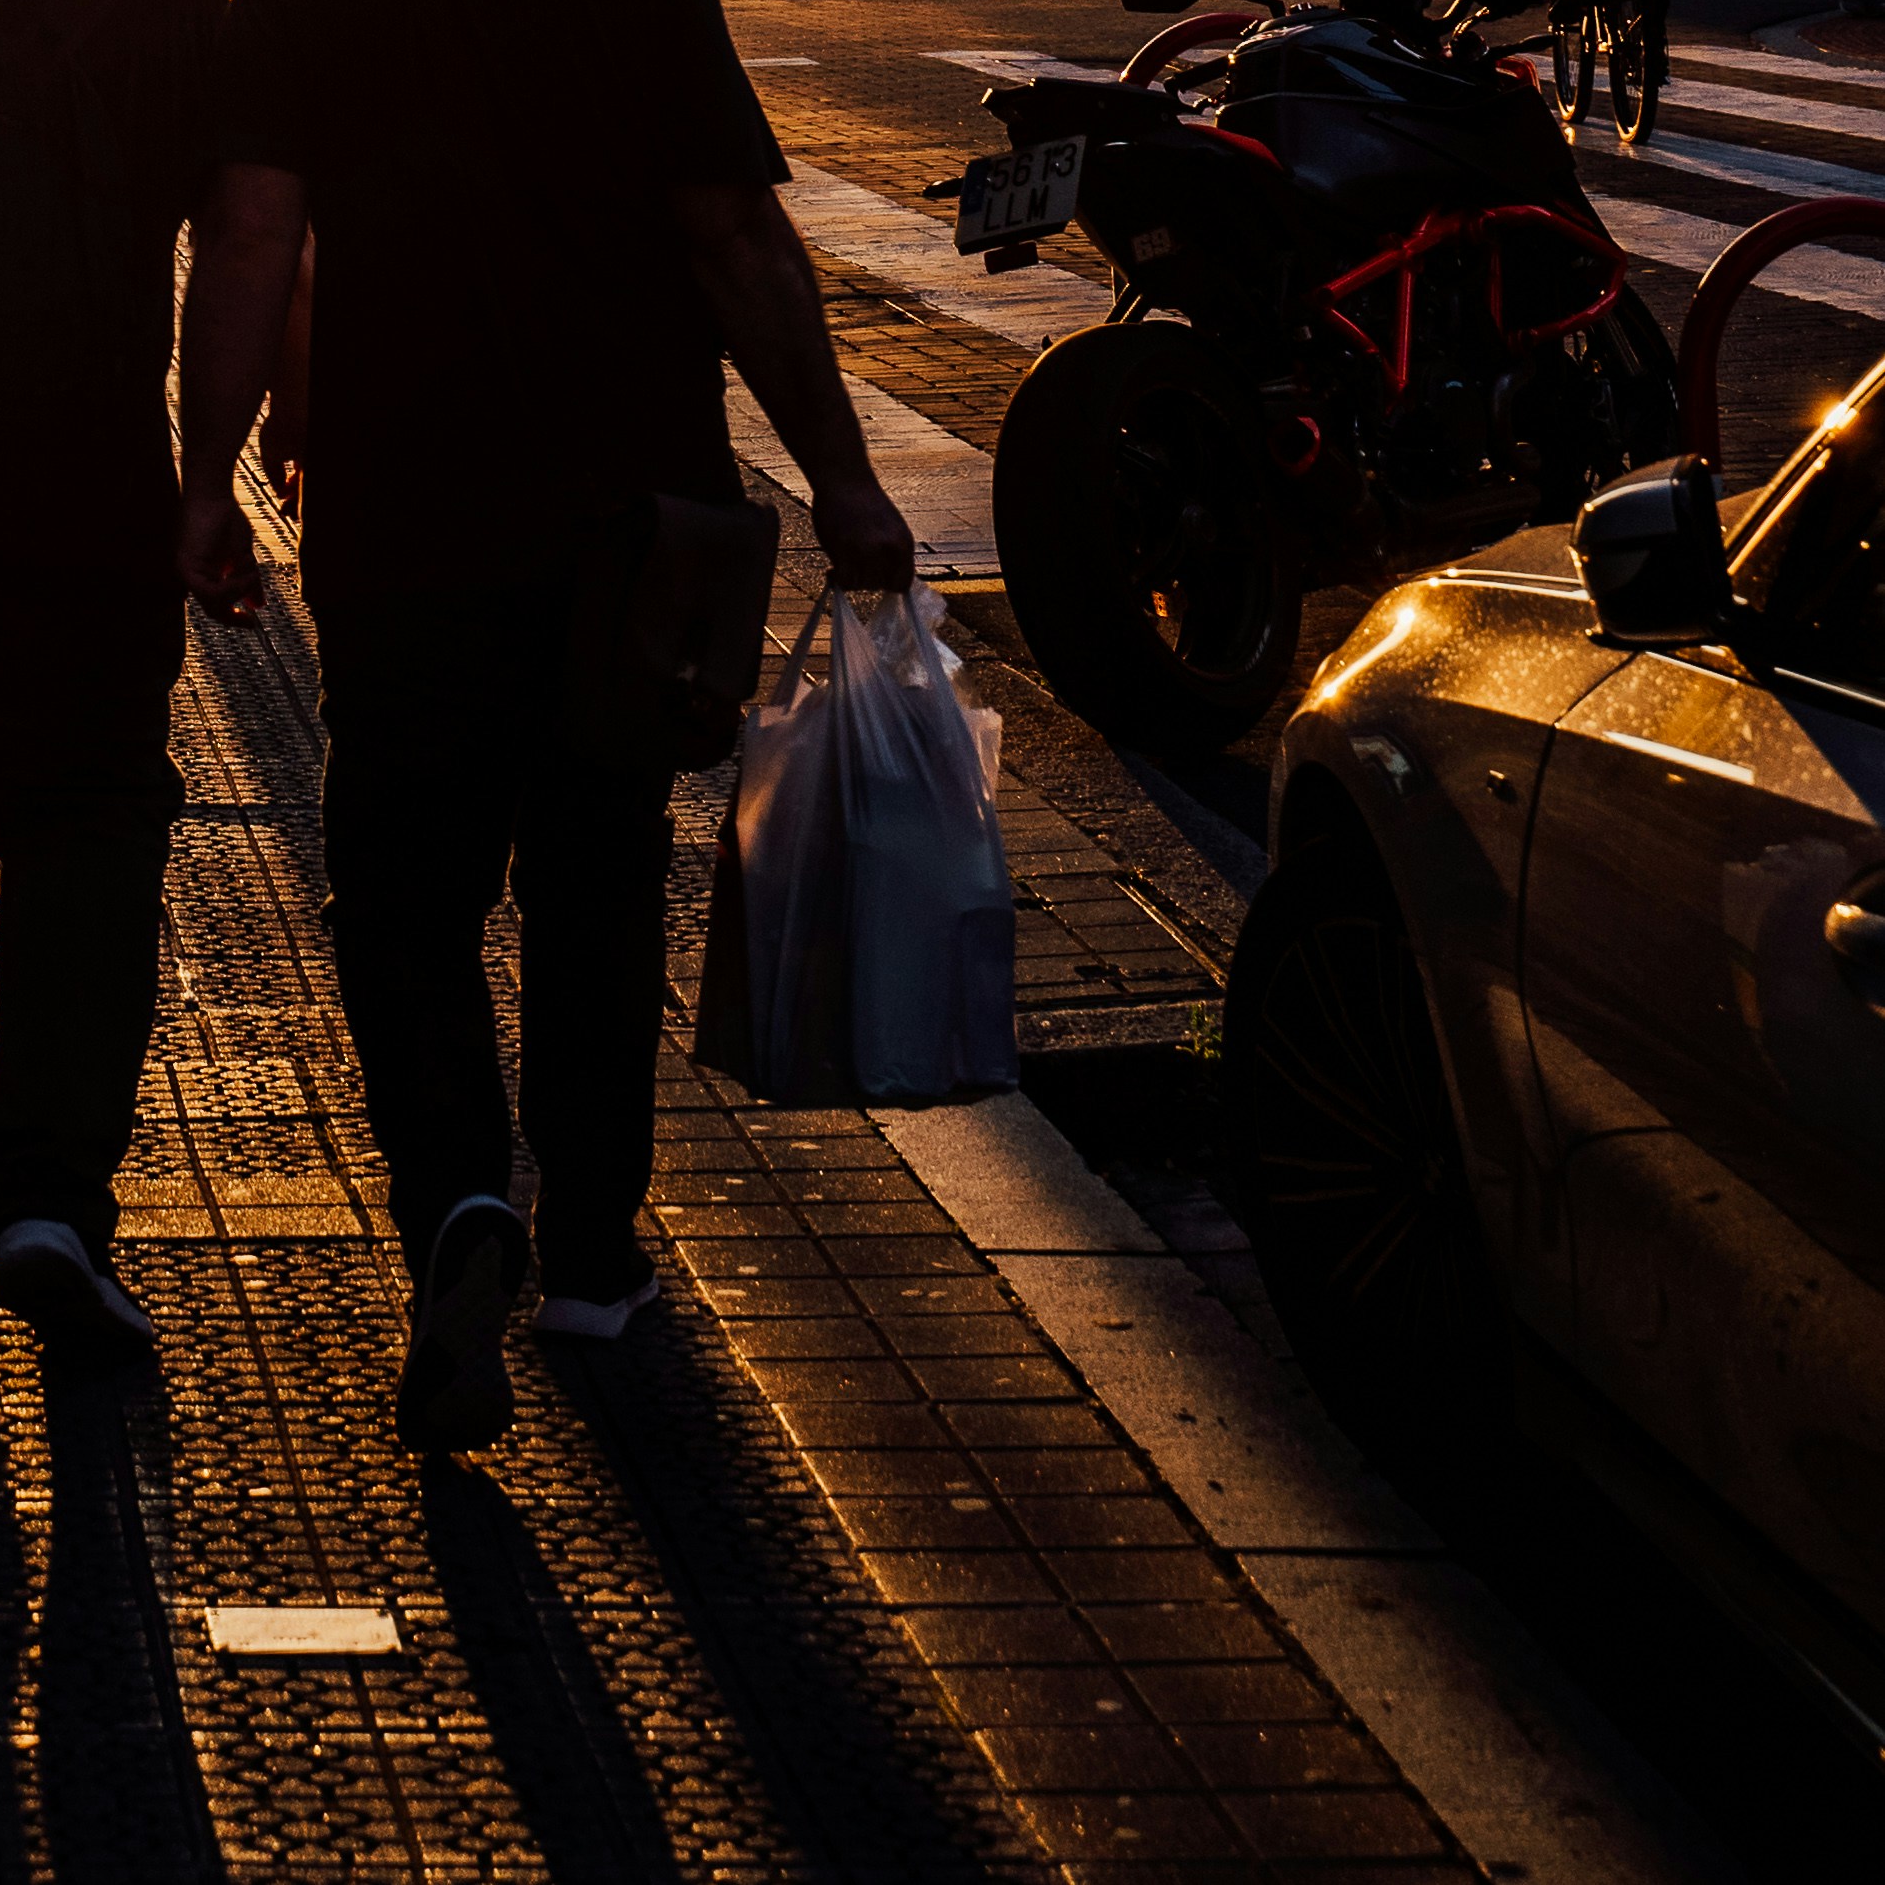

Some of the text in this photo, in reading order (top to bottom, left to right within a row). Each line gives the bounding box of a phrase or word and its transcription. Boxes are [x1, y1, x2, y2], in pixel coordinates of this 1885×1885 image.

[989, 142, 1077, 192] 5613
[984, 184, 1049, 233] LLM
[1130, 226, 1171, 265] 69
